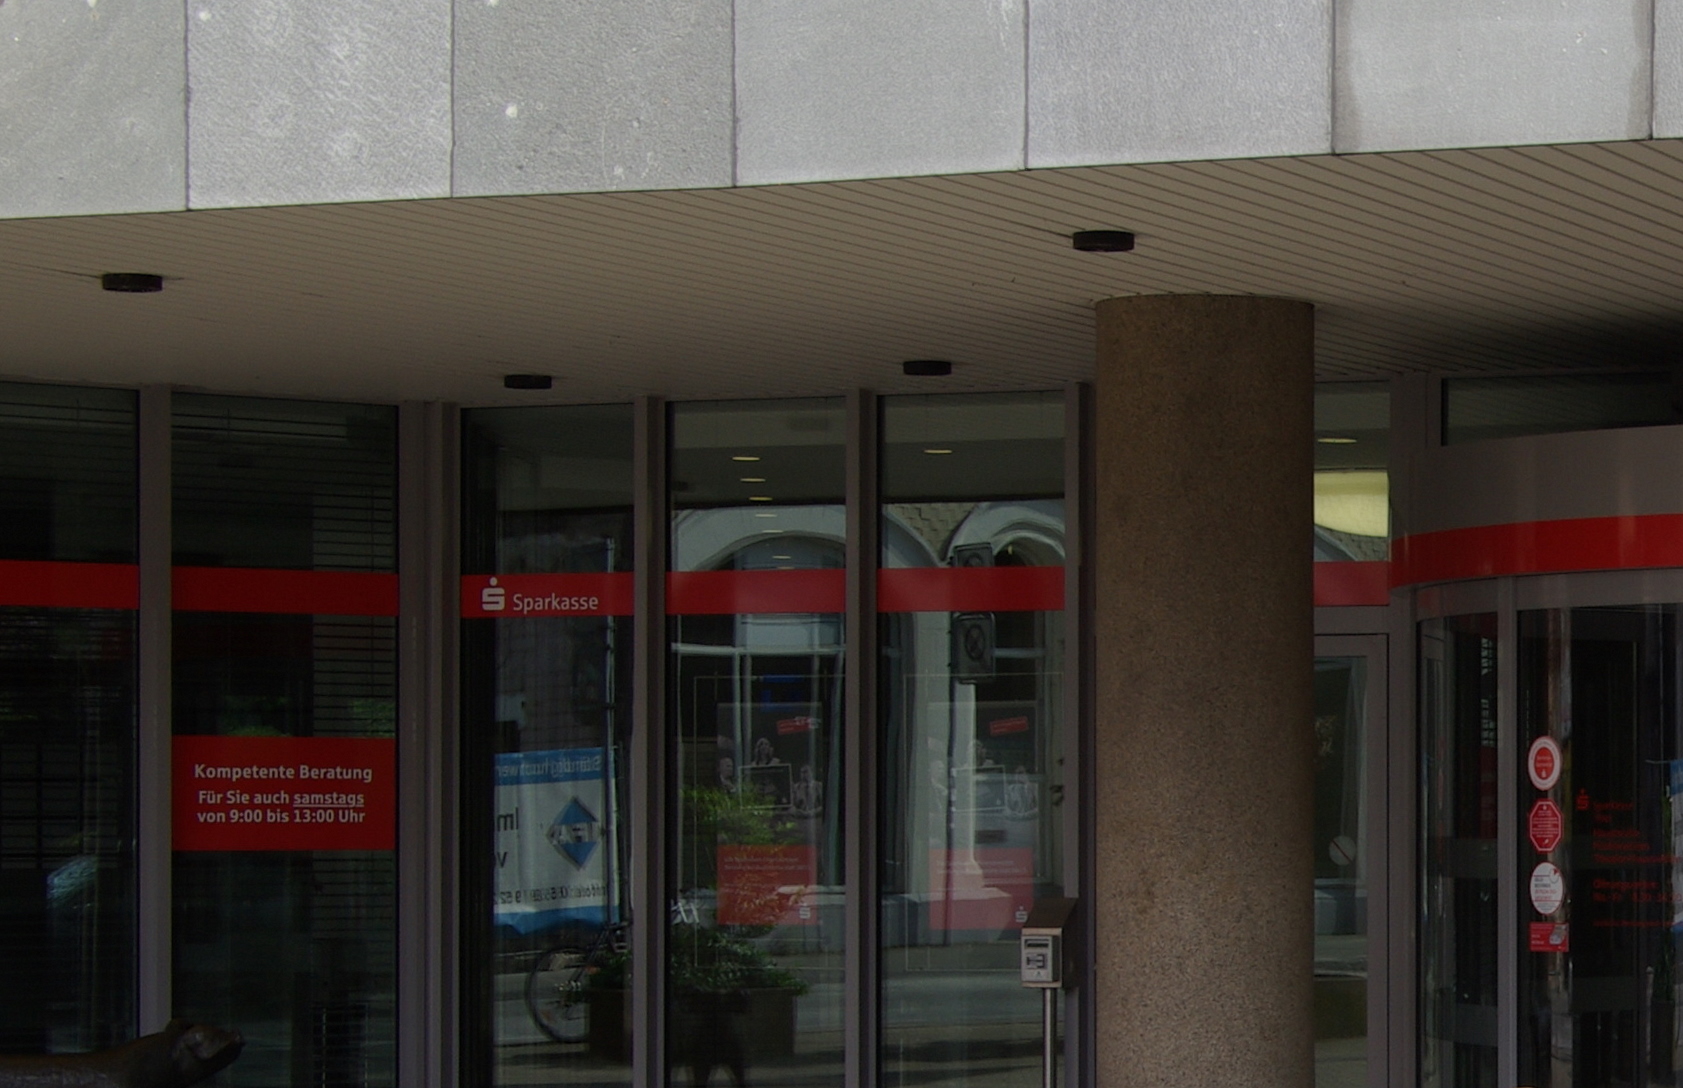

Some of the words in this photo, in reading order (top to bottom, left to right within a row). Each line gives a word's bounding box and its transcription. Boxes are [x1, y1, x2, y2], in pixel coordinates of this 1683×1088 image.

[512, 592, 599, 615] Sparkasse
[194, 763, 295, 782] Kompetente
[299, 764, 373, 783] Beratung
[198, 789, 223, 804] Für
[226, 789, 250, 804] Sie
[253, 790, 290, 804] auch
[292, 791, 365, 807] samstags
[197, 812, 226, 823] von
[229, 809, 263, 823] 9:00
[266, 808, 290, 823] bis
[293, 809, 335, 823] 13:00
[338, 809, 366, 823] Uhr
